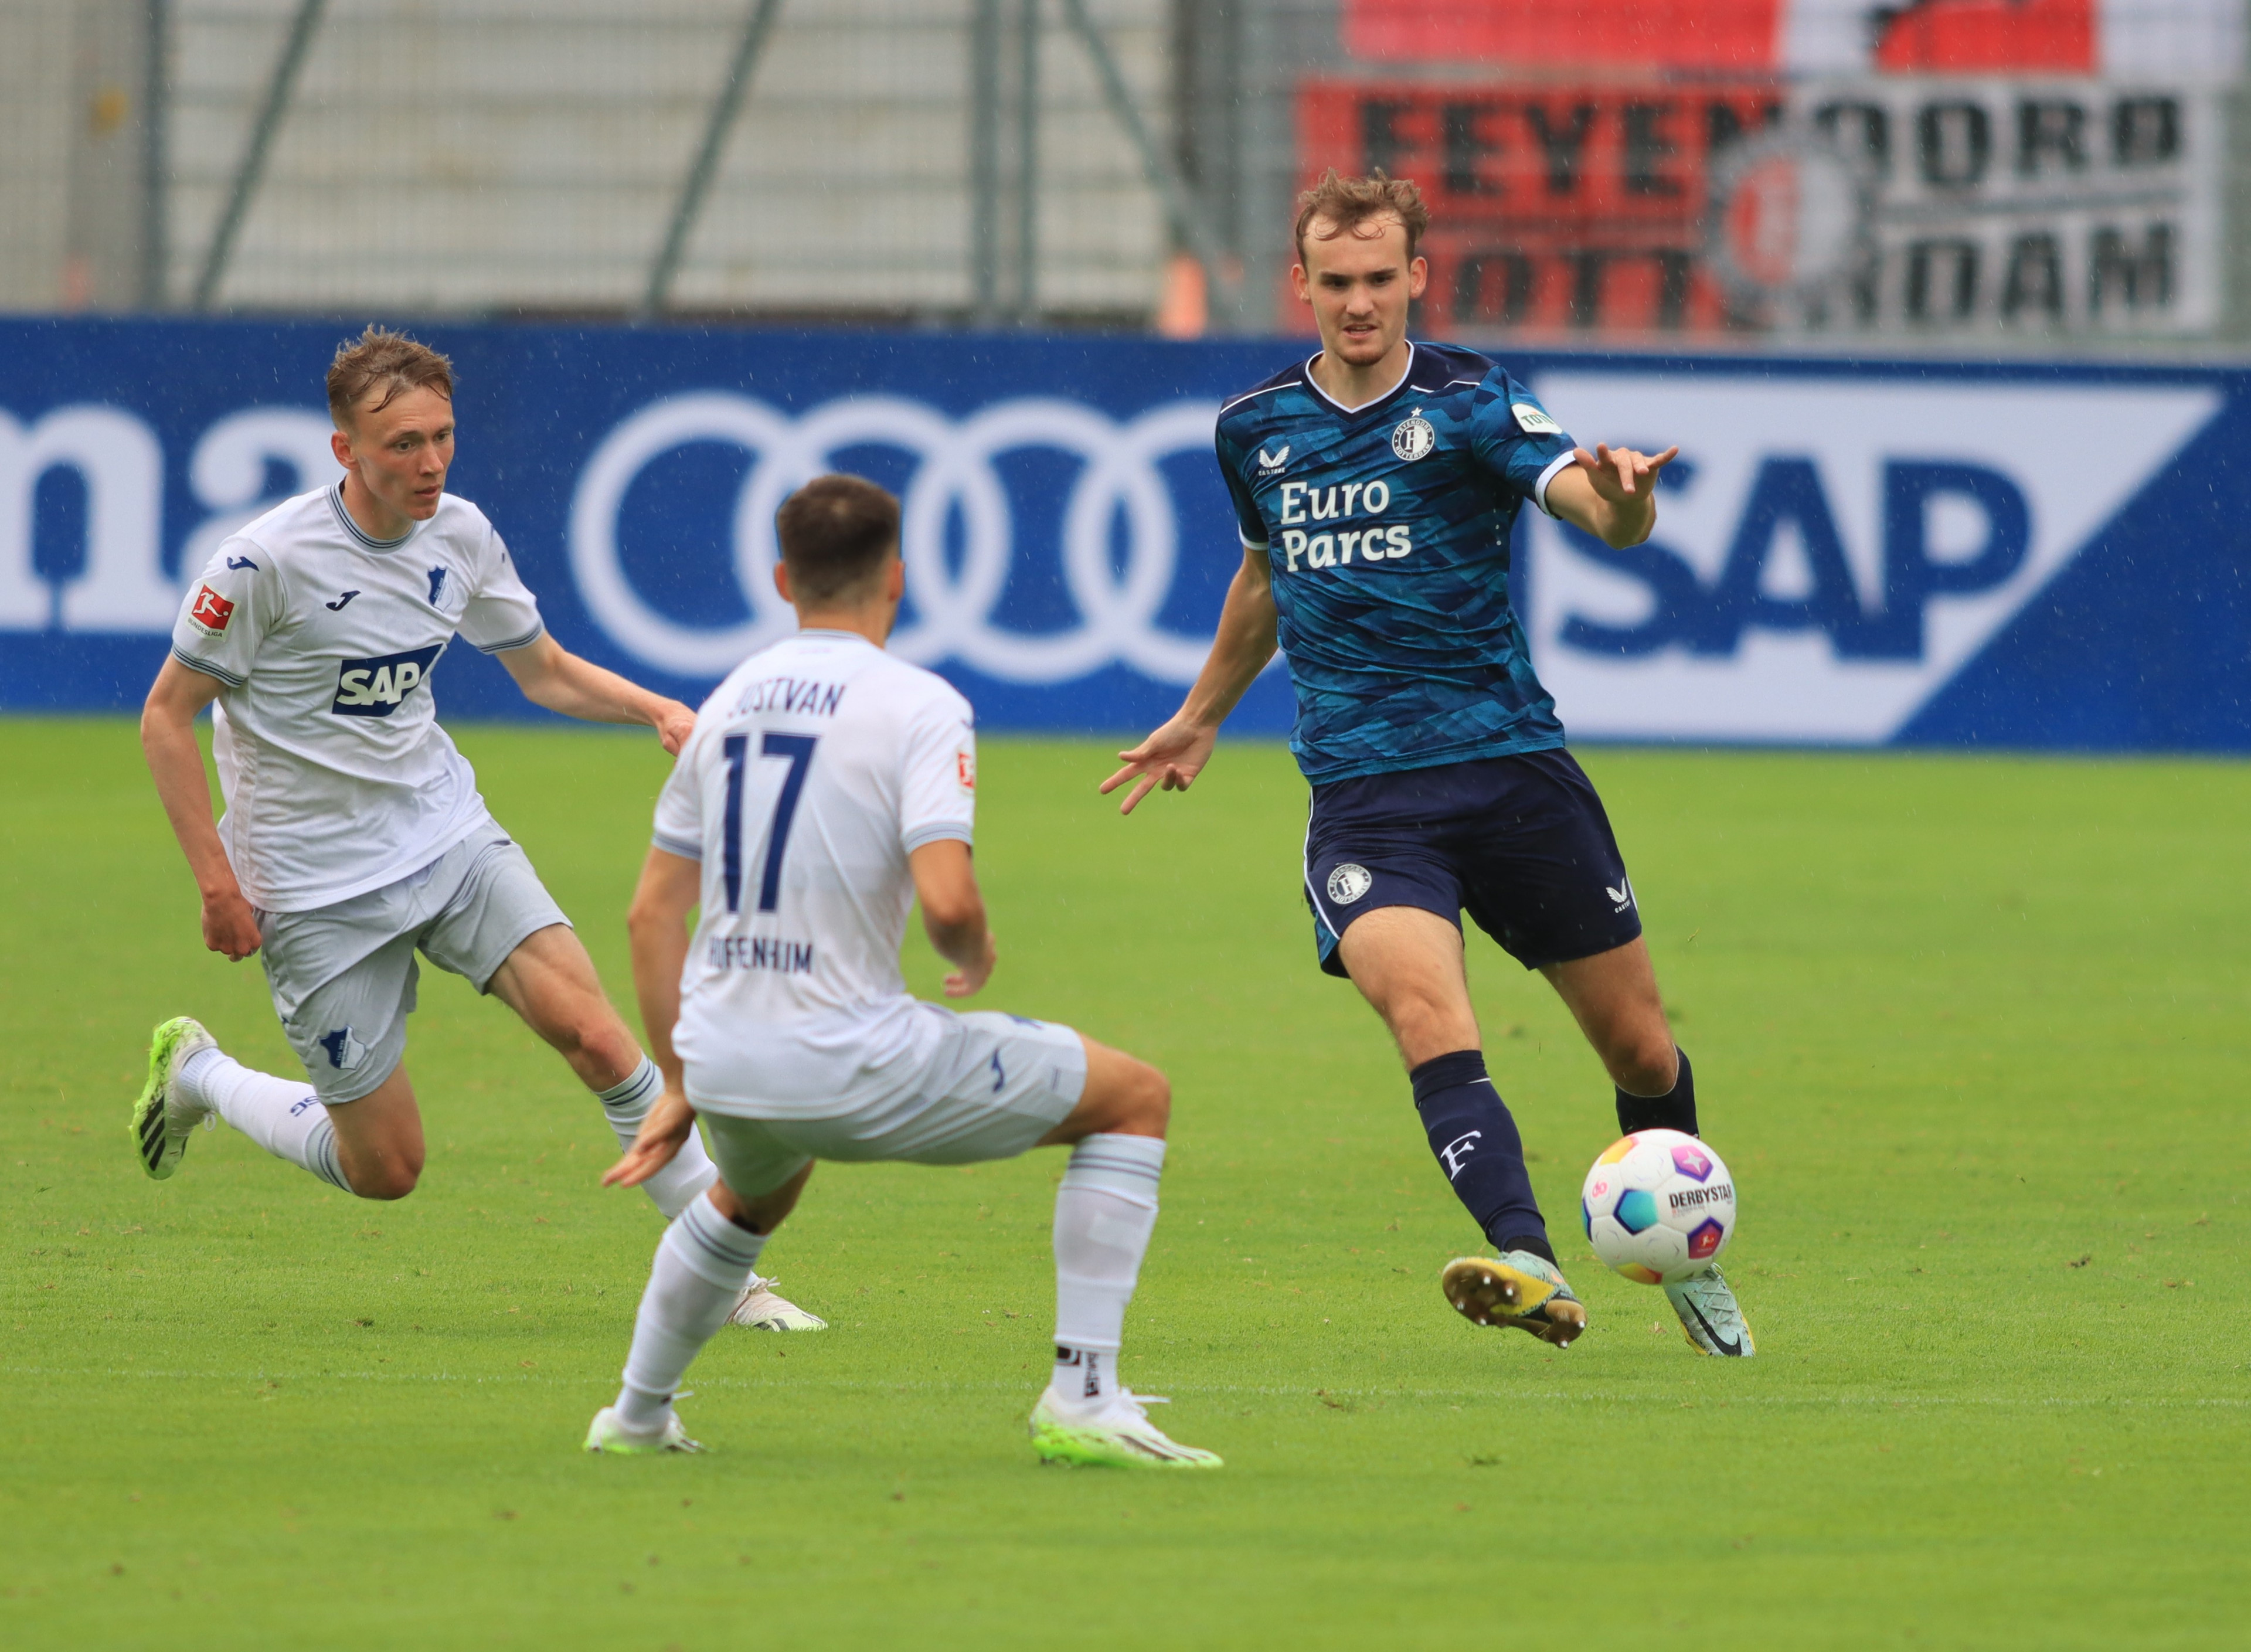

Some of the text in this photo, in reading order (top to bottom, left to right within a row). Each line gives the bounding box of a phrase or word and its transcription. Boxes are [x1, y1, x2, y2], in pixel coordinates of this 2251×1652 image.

[1406, 222, 2174, 331] OTTDAM
[1396, 420, 1431, 435] FEYENOORD
[1280, 480, 1390, 525] Euro
[1282, 525, 1412, 572] Parcs
[1556, 444, 2033, 662] SAP
[188, 617, 223, 637] BUNDESLIGA
[340, 662, 420, 706] SAP
[723, 730, 822, 916] 17
[1668, 1183, 1733, 1208] DERBYSTAR
